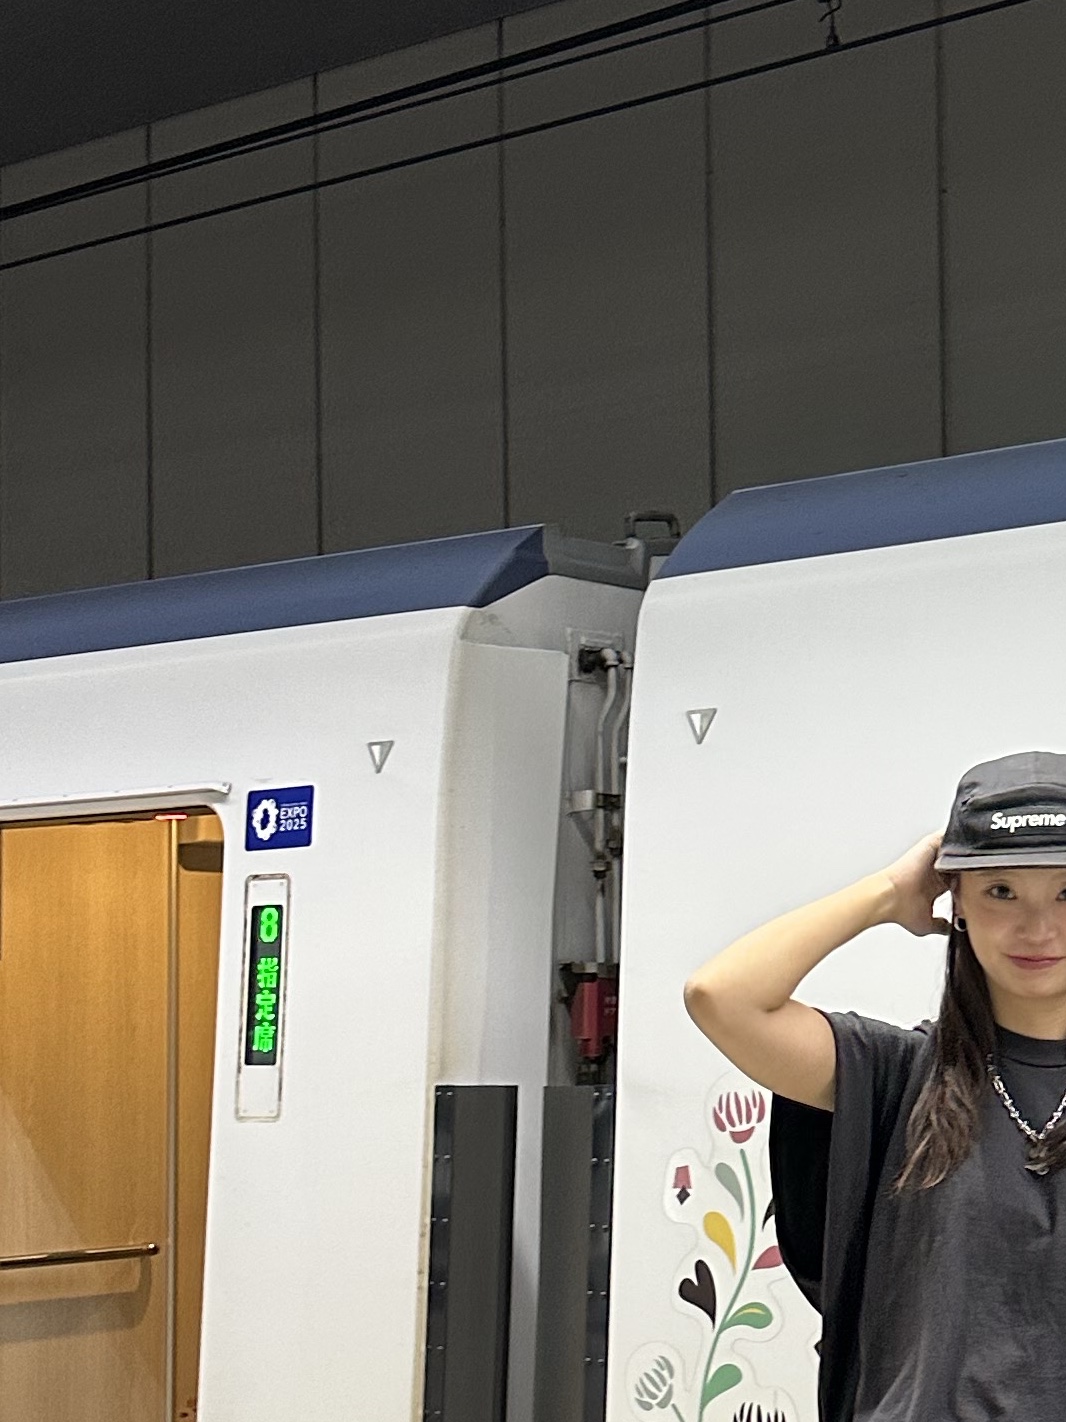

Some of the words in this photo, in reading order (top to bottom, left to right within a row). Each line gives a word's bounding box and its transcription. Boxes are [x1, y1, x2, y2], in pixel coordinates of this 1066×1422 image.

[279, 806, 308, 819] EXPO
[990, 811, 1066, 833] Supreme
[279, 818, 307, 831] 2025
[259, 907, 279, 943] 8
[252, 957, 279, 1052] 指定席
